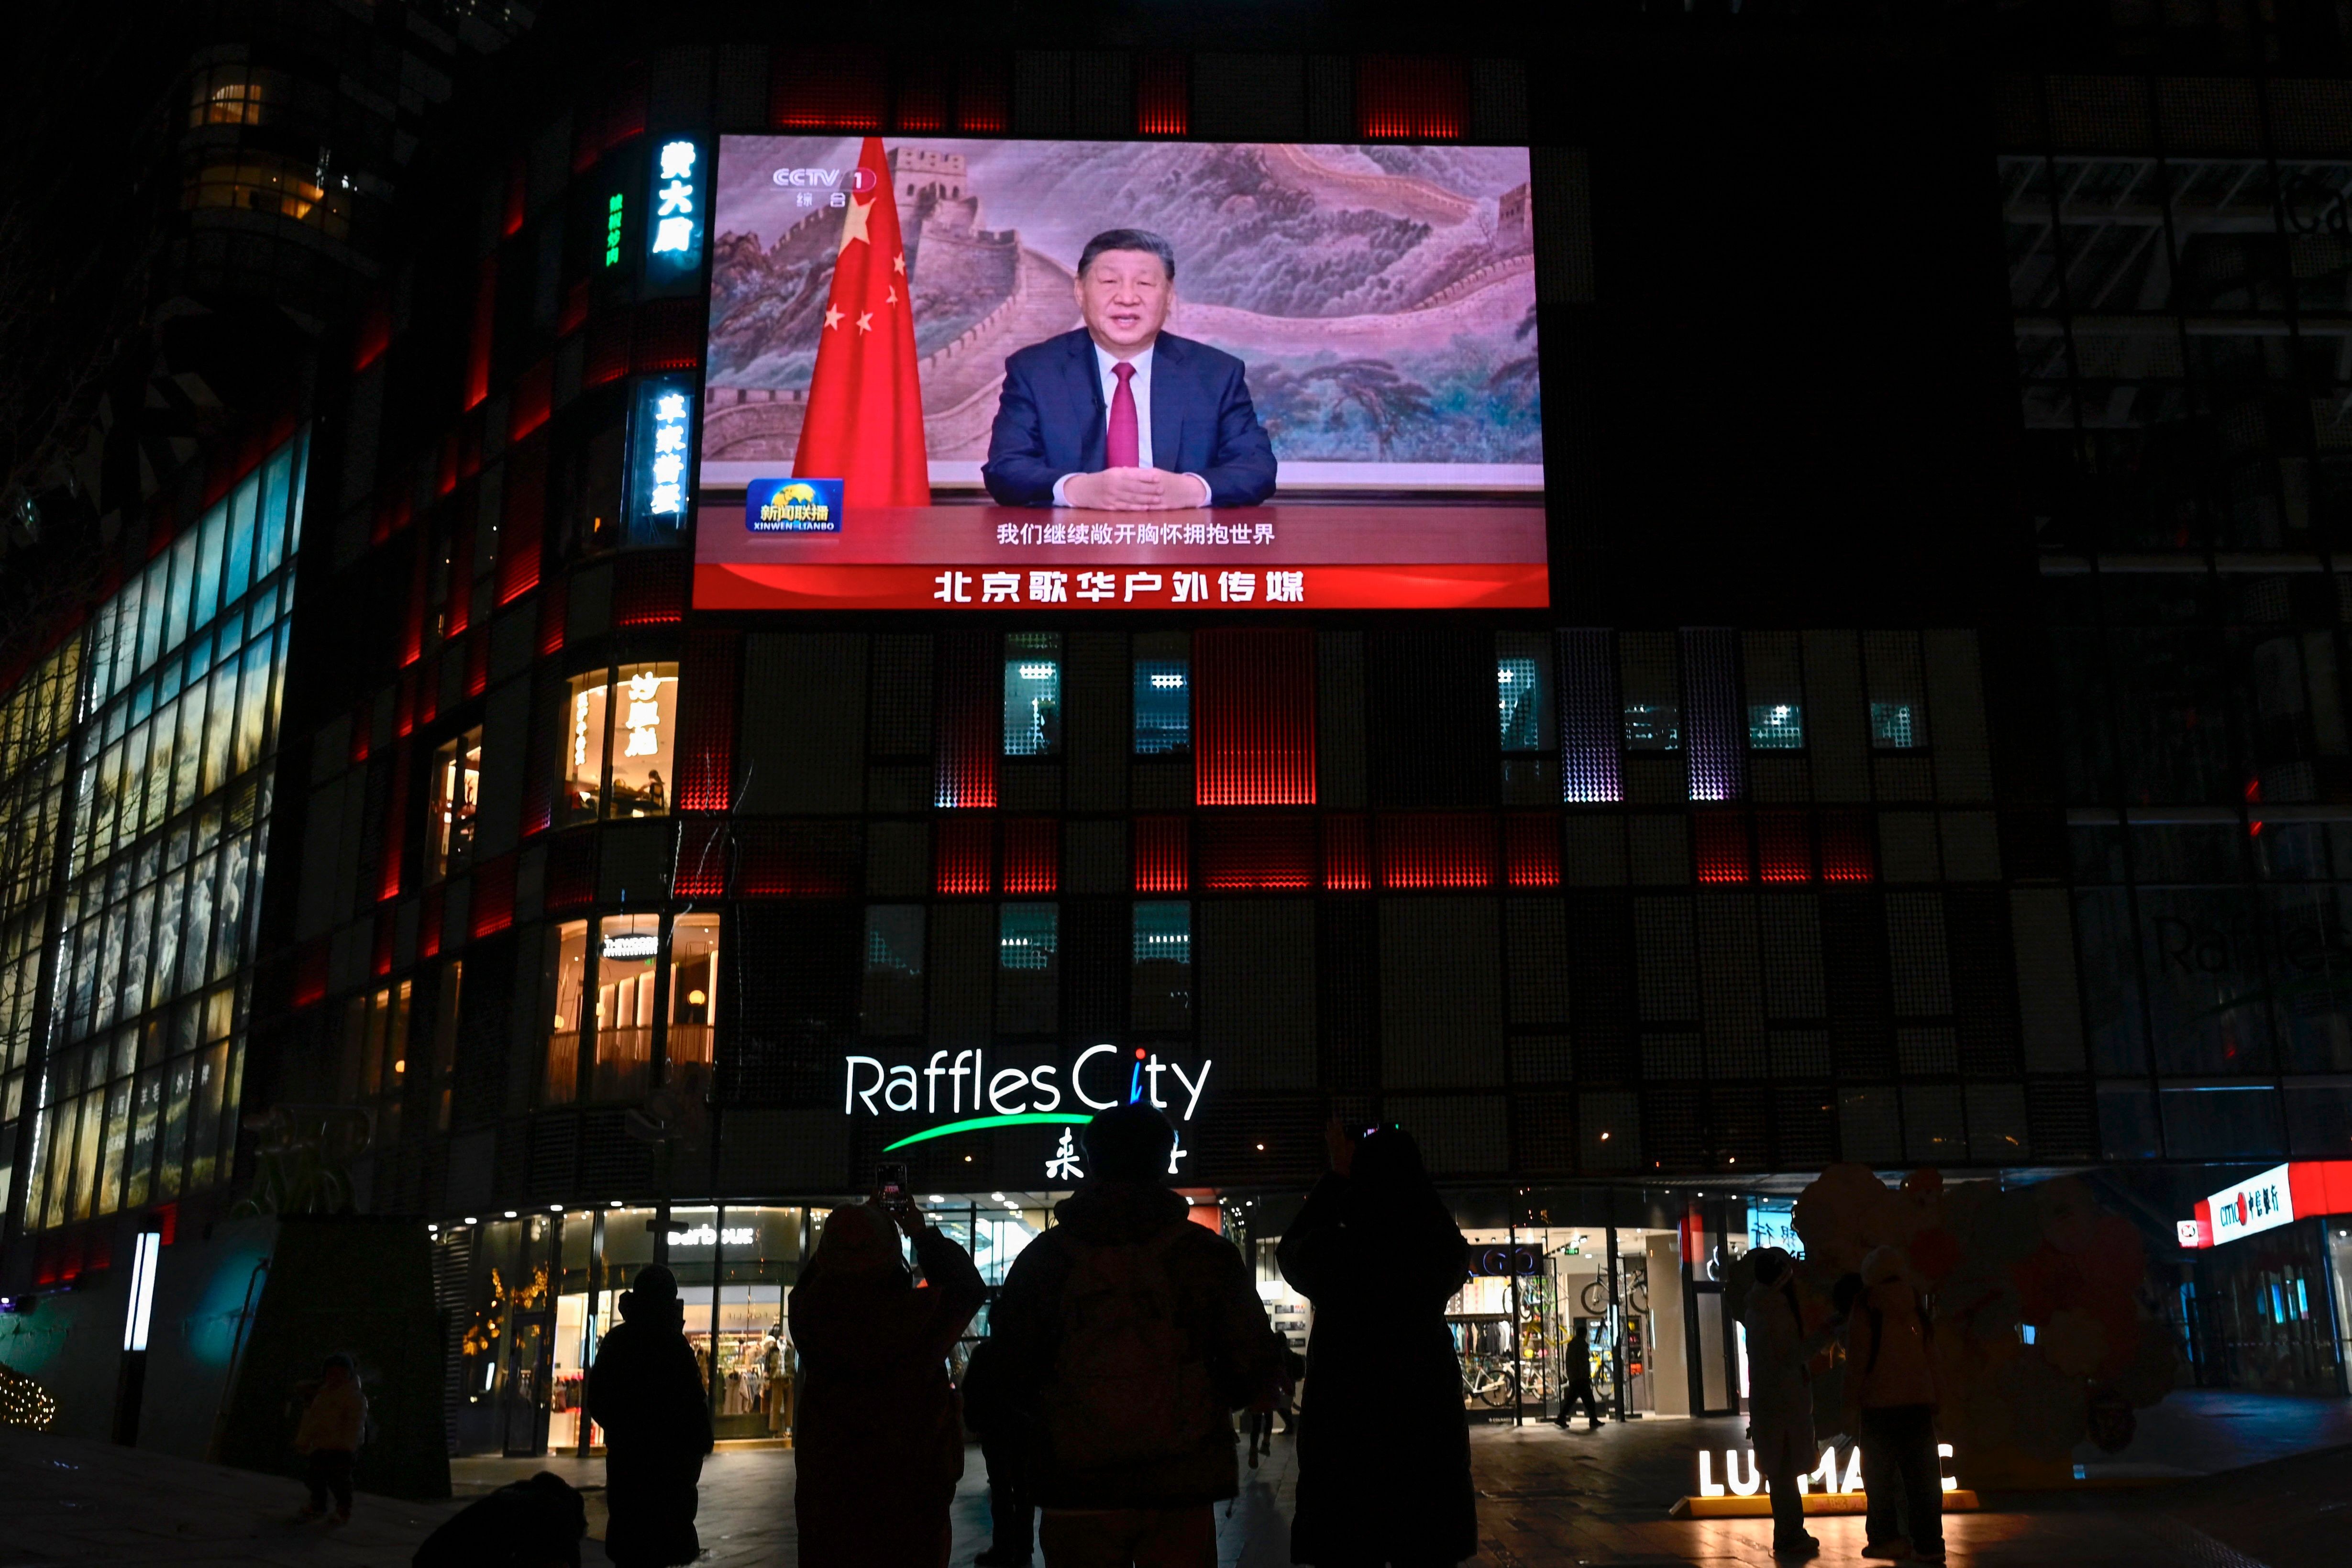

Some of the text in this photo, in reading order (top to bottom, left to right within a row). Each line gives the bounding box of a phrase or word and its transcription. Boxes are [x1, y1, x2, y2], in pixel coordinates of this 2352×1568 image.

[773, 168, 862, 189] CCTV 1
[761, 505, 828, 521] 新闻联播
[754, 522, 834, 530] XINWEN LIANBO
[997, 523, 1275, 545] 我们继续敞开胸怀拥抱世界
[934, 571, 1304, 603] 北京歌华户外传媒
[845, 1044, 1212, 1120] Raffles City
